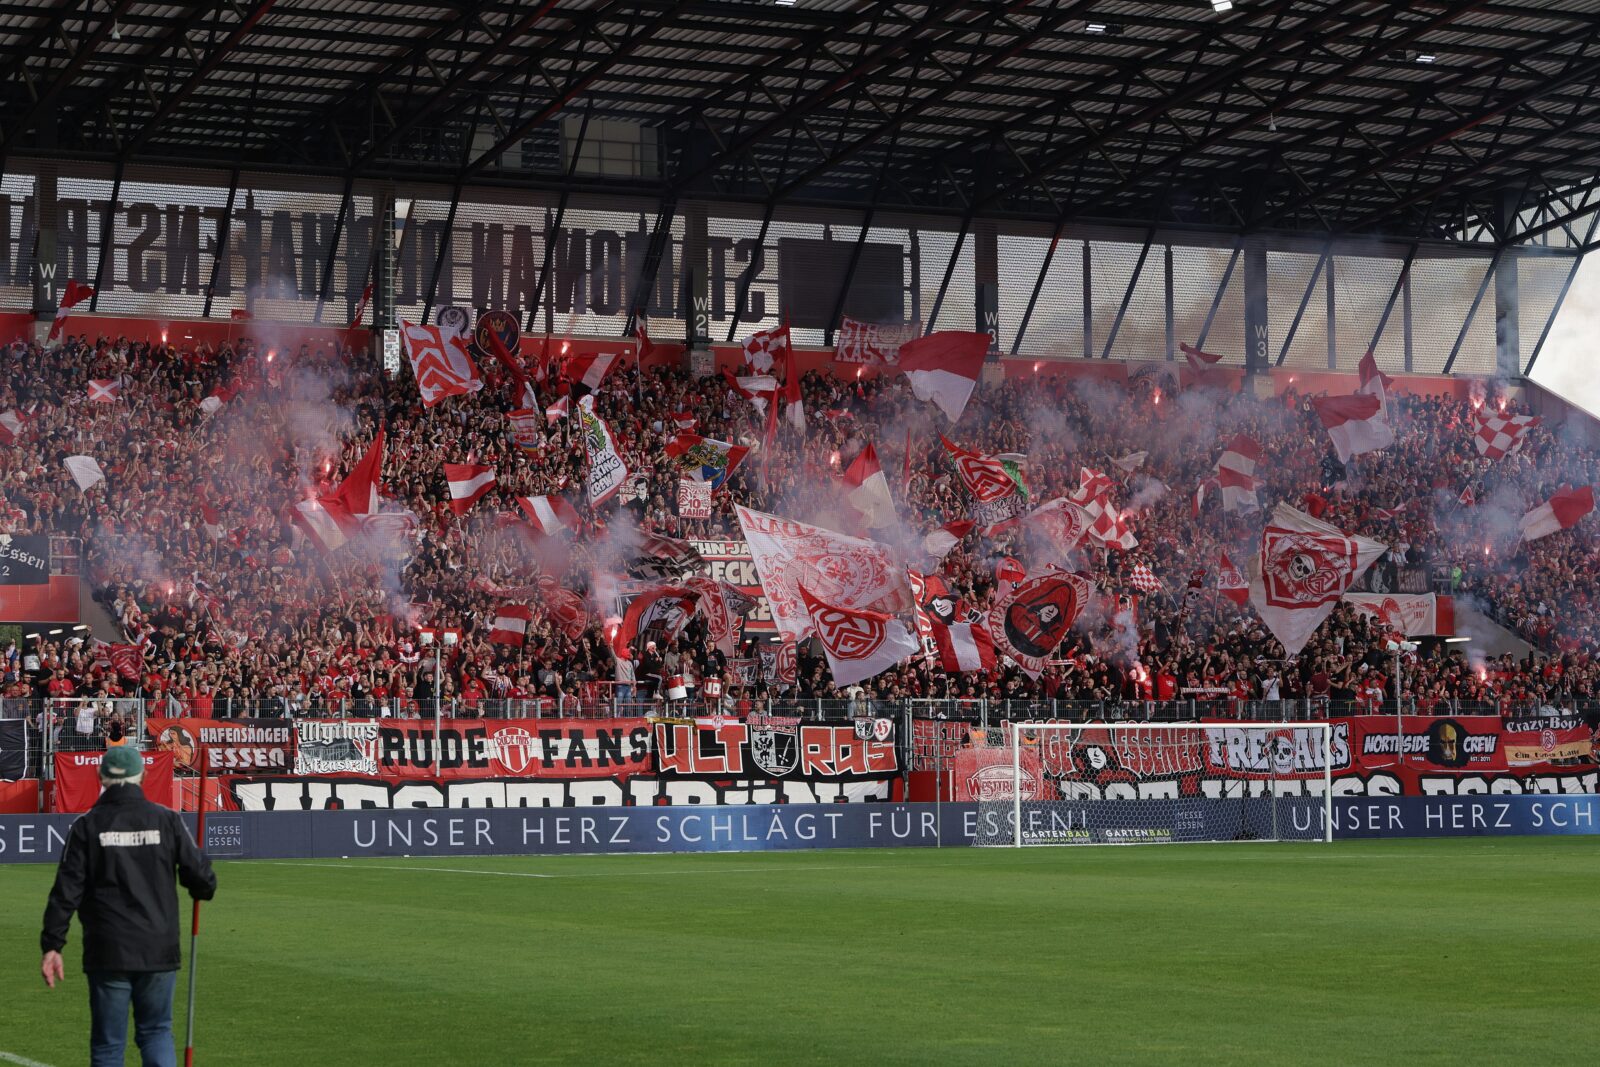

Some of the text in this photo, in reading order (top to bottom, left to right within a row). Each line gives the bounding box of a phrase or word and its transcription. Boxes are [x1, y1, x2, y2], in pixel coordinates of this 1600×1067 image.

[39, 263, 57, 301] W 1
[693, 296, 708, 332] W 2
[984, 311, 999, 326] W
[681, 508, 709, 517] JAHRE
[687, 498, 701, 509] 10
[200, 724, 289, 744] HAFENSÄNGER
[379, 726, 649, 768] RUDE FANS
[1463, 735, 1496, 753] CREW
[208, 746, 286, 768] ESSEN
[1292, 802, 1592, 831] UNSER HERZ SCH
[208, 825, 240, 835] MESSE
[353, 818, 494, 847] UNSER
[522, 817, 631, 845] HERZ
[656, 809, 843, 843] SCHLÄGT
[869, 807, 938, 839] FÜR
[1022, 830, 1090, 838] GARTENBAU
[1105, 829, 1170, 837] GARTENBAU
[208, 837, 241, 846] ESSEN
